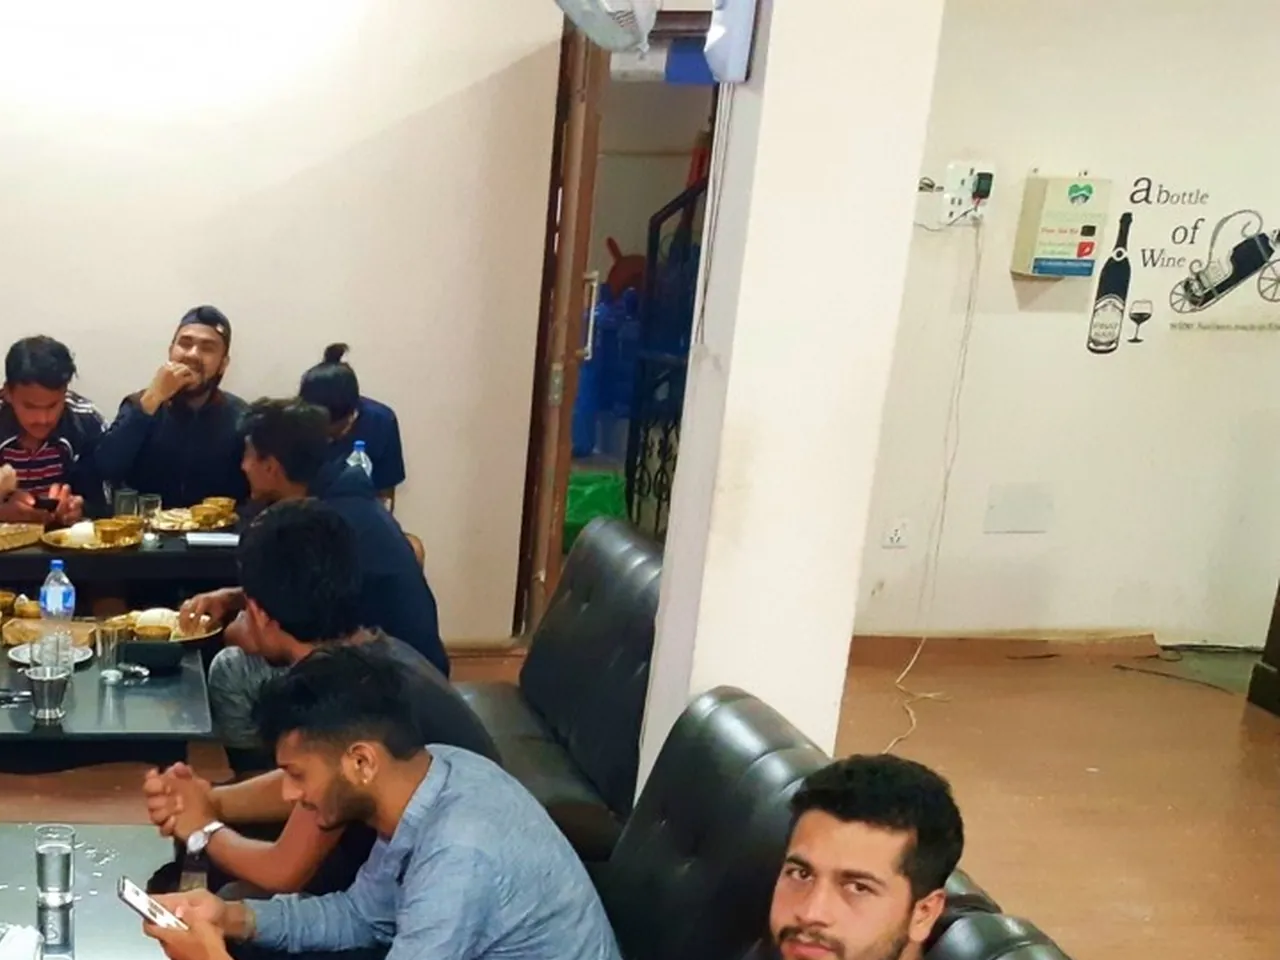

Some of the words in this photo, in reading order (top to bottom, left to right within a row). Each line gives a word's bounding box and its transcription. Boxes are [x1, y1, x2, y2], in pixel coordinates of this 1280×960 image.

[1130, 177, 1152, 204] a
[1157, 184, 1209, 204] bottle
[1171, 218, 1205, 244] of
[1141, 248, 1186, 267] Wine
